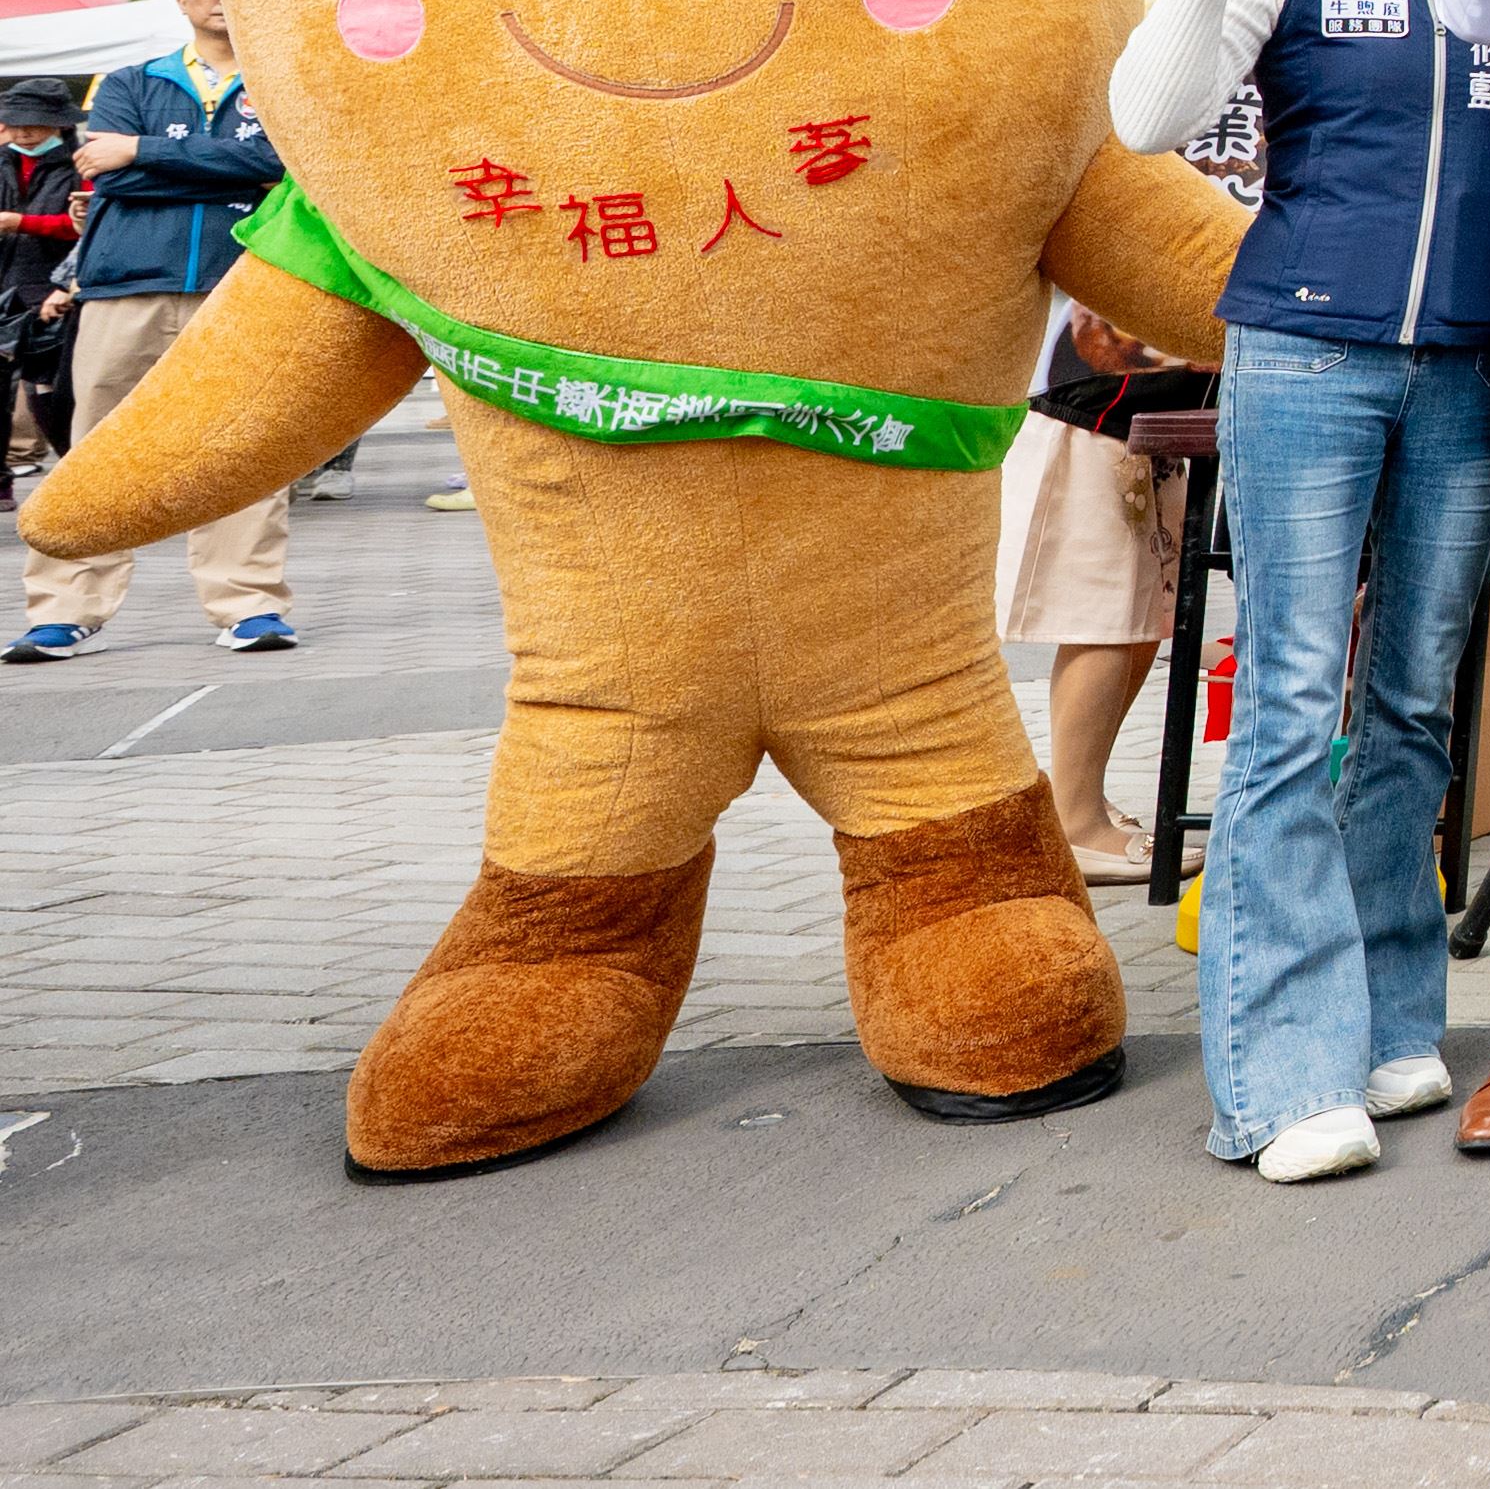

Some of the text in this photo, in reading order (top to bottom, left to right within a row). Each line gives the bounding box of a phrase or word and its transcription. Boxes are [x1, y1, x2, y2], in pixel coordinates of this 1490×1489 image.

[1329, 0, 1401, 16] 牛煦庭
[1328, 19, 1403, 33] 服務團隊
